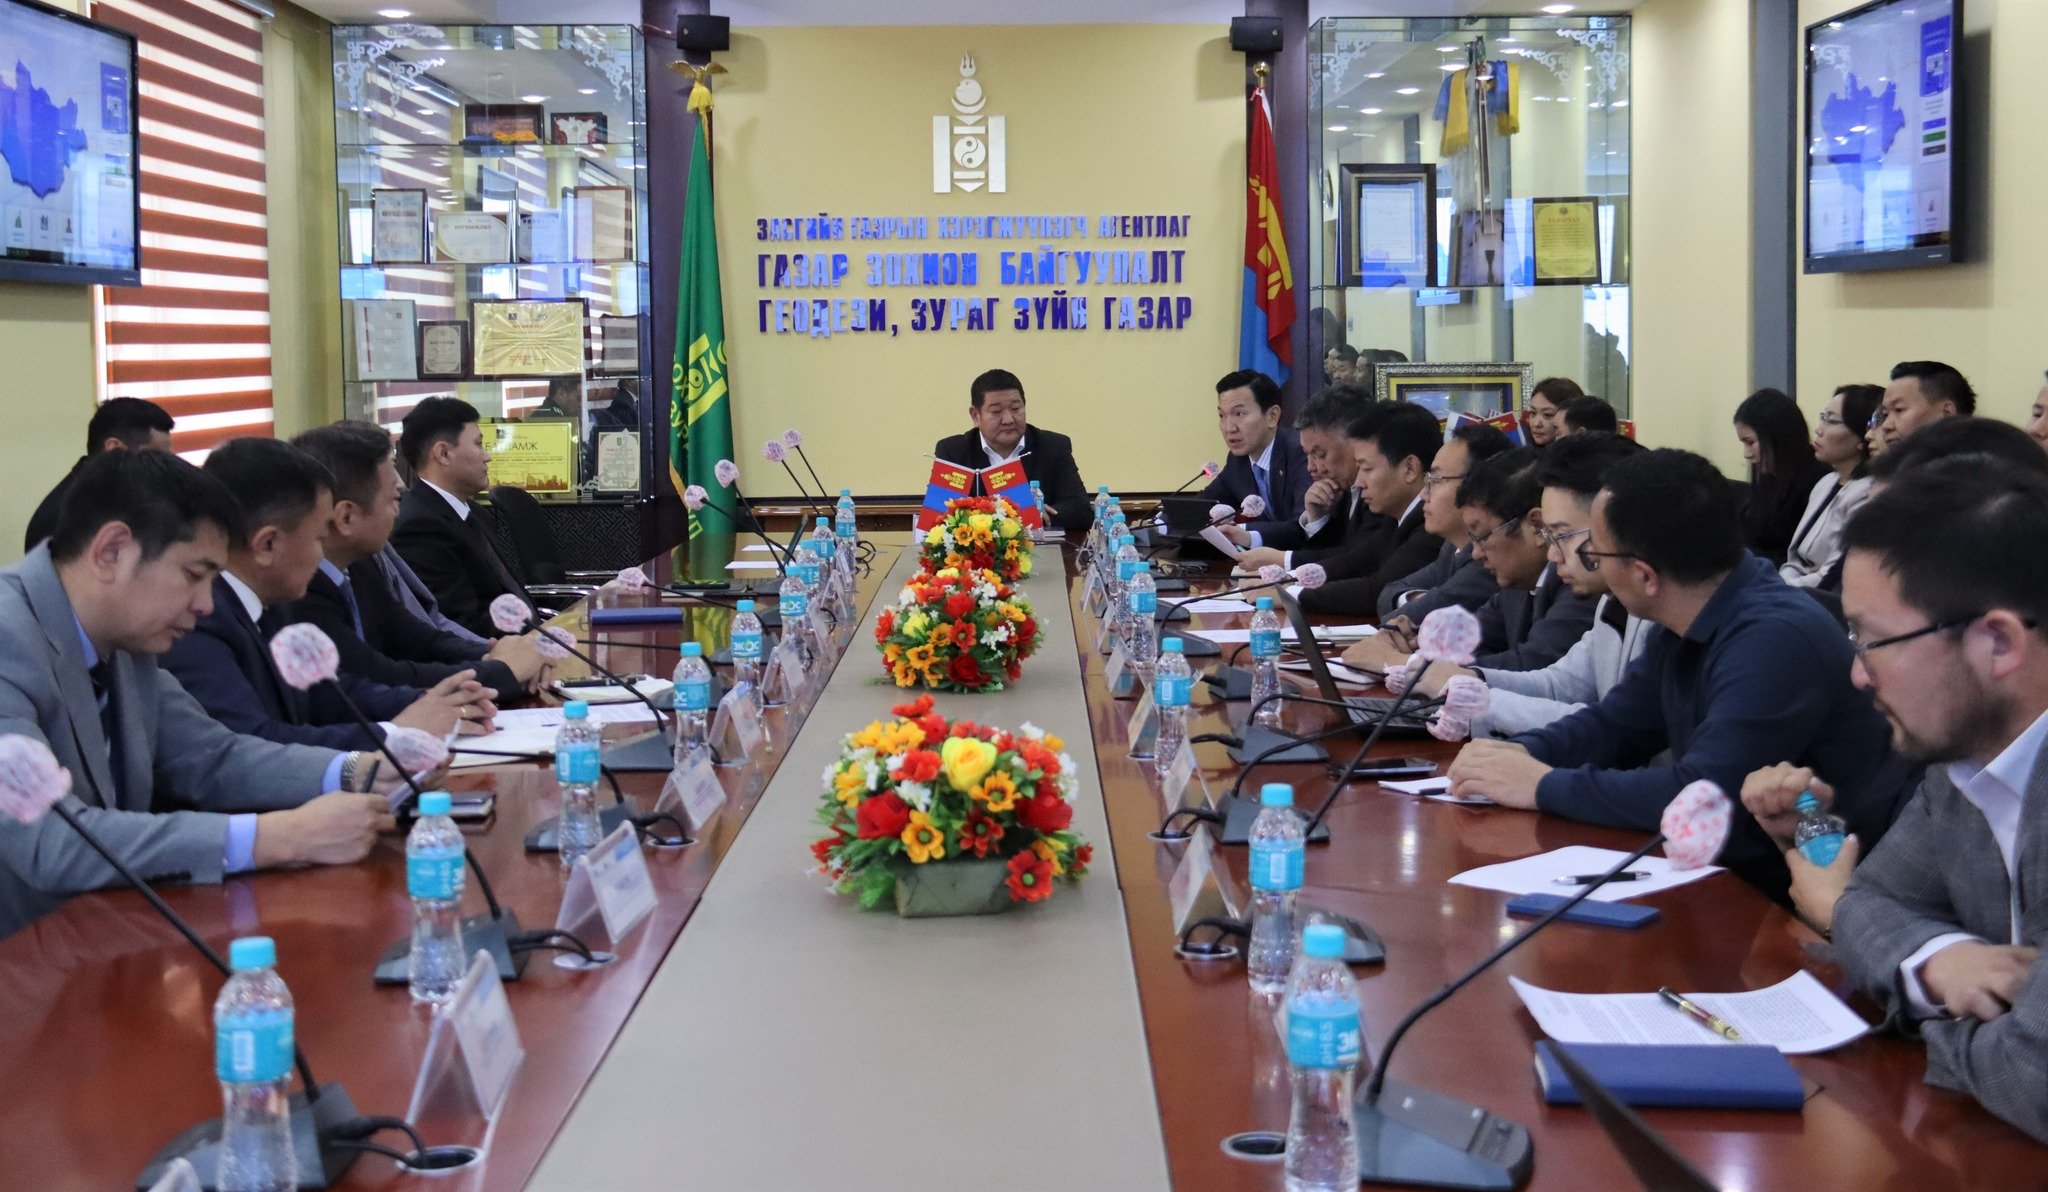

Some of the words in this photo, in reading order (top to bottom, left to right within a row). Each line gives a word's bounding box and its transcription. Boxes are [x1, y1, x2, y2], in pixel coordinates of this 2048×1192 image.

[757, 213, 843, 240] ЗАСГИЙН
[850, 216, 927, 240] ГАЗРЫН
[938, 215, 1088, 239] ХЭРЭГЖҮҮЛЭГЧ
[1098, 215, 1191, 238] АГЕНТЛАГ
[758, 253, 848, 287] ГАЗАР
[866, 252, 977, 286] ЗОХИОН
[1000, 244, 1186, 285] БАЙГУУЛАЛТ
[759, 298, 898, 338] ГЕОДЕЗИ,
[911, 297, 1000, 331] ЗУРАГ
[1014, 290, 1087, 330] ЗҮЙН
[1104, 296, 1192, 330] ГАЗАР
